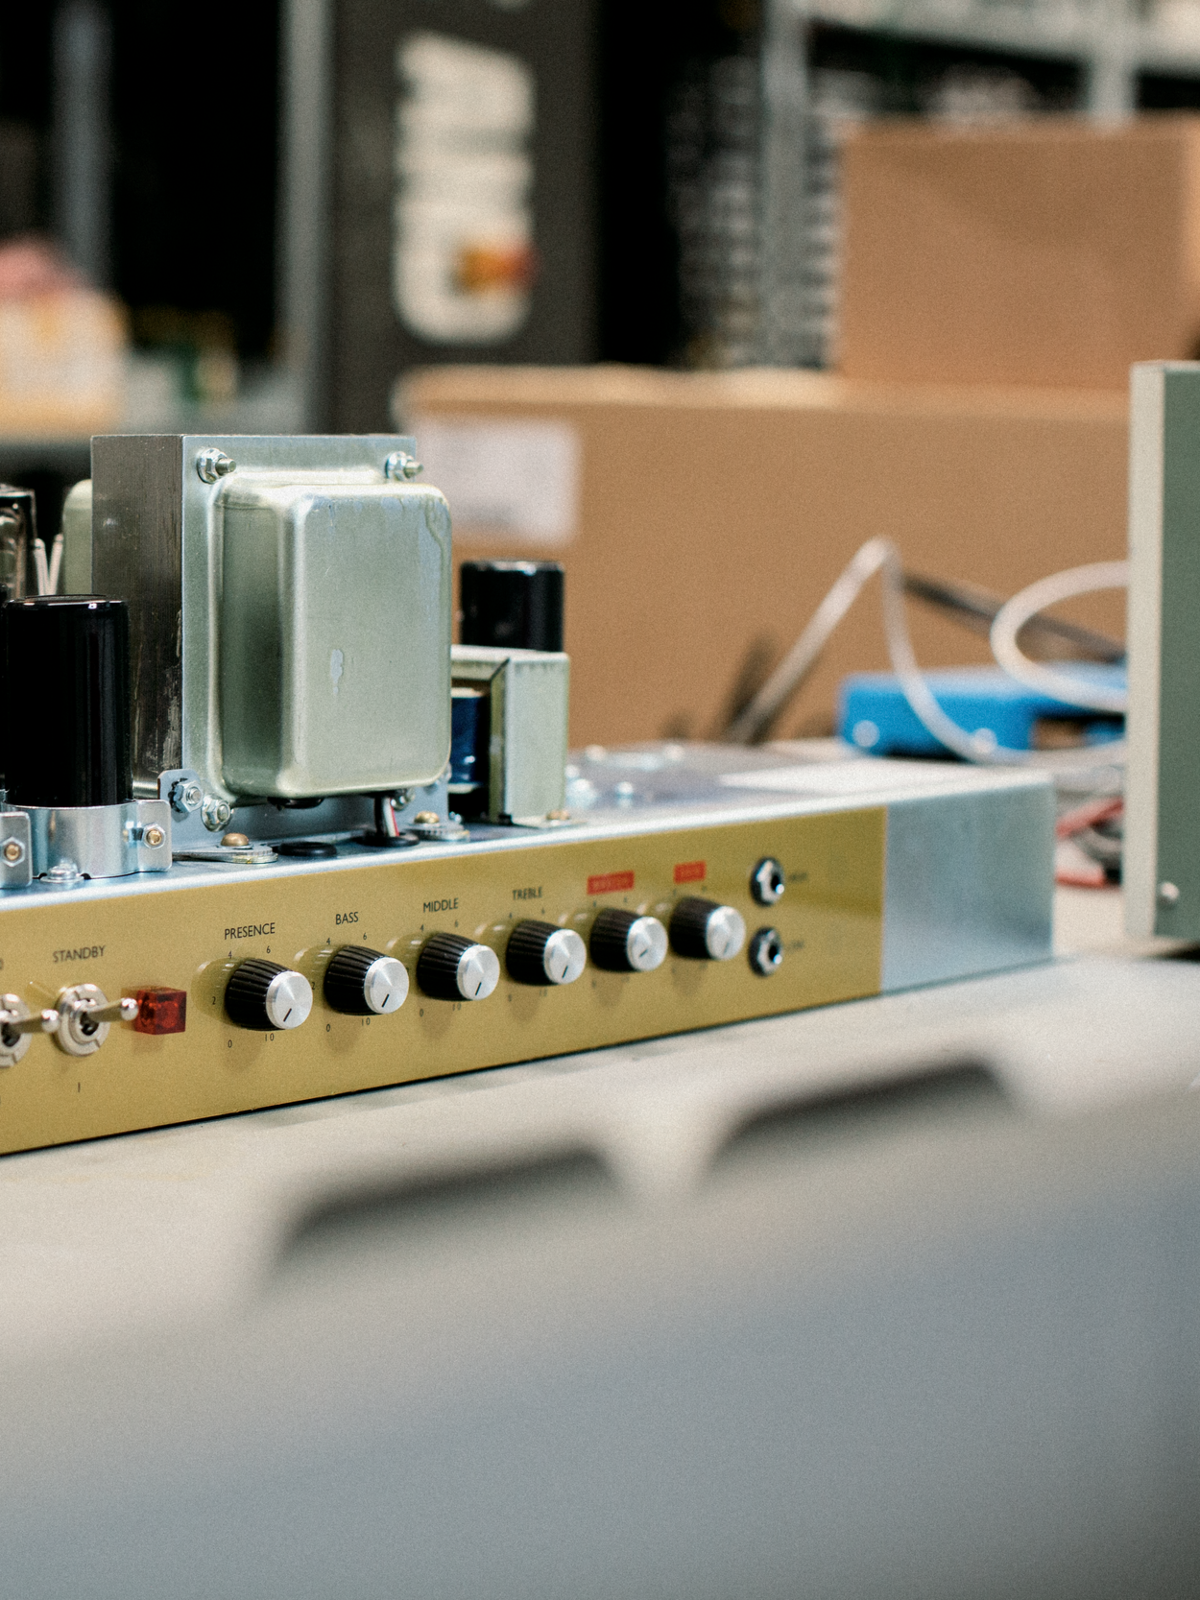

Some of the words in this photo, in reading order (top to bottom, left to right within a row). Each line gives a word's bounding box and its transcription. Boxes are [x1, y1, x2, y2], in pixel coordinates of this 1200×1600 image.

[512, 886, 543, 901] TREBLE
[423, 898, 459, 913] MIDDLE
[335, 911, 359, 926] BASS
[224, 922, 276, 940] PRESENCE
[326, 937, 331, 946] 4
[362, 932, 368, 941] 6
[52, 945, 106, 964] STANDBY
[227, 950, 233, 959] 4
[266, 945, 271, 954] 6
[211, 996, 217, 1006] 2
[326, 1023, 331, 1033] 0
[227, 1039, 233, 1049] 0
